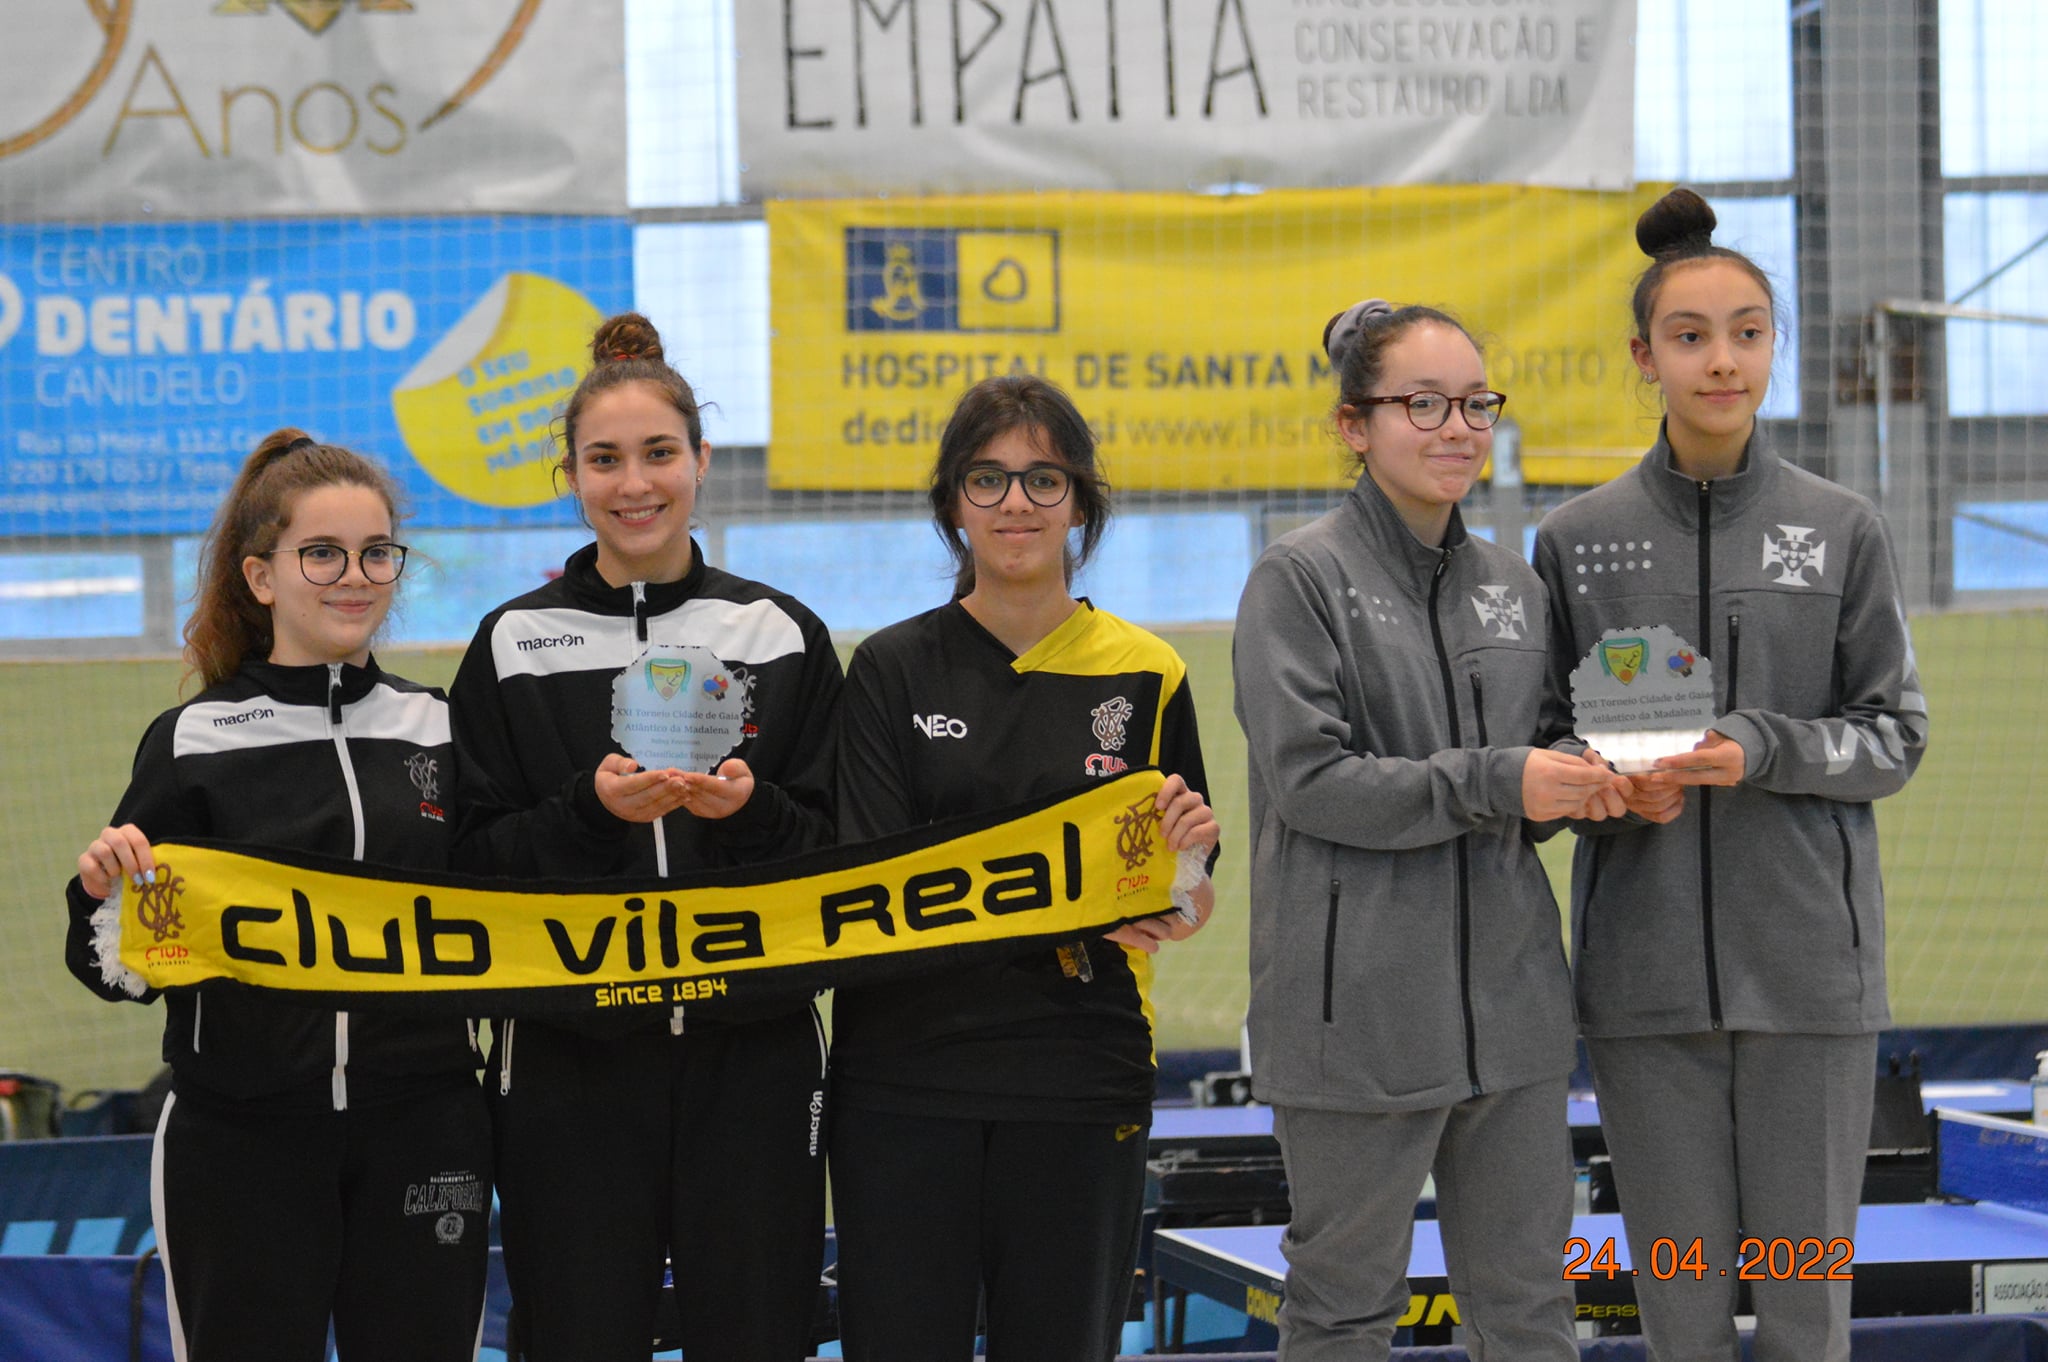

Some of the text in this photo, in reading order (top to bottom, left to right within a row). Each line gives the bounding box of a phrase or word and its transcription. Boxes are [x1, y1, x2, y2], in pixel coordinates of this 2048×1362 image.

[1574, 15, 1600, 62] E
[103, 45, 409, 158] Anos
[1297, 71, 1569, 119] RESTAURO LDA
[34, 244, 205, 287] CENTRO
[37, 279, 417, 355] DENTÁRIO
[36, 362, 248, 407] CANIDELO
[842, 352, 1048, 388] HOSPITAL
[1076, 354, 1129, 389] DE
[1145, 353, 1292, 388] SANTA
[515, 634, 585, 652] macron
[616, 708, 739, 721] XXI Torneio Cidade de Gaia
[1580, 691, 1709, 710] XXI Torneio Cidade de Gaia
[1591, 707, 1702, 724] Atlântico da Madalena
[213, 706, 275, 728] macron
[624, 722, 730, 735] Atlântico da Madalena
[913, 713, 968, 740] NEO
[690, 751, 719, 762] Equipas
[220, 822, 1082, 976] club vila Real
[595, 977, 728, 1007] since 1894
[809, 1090, 823, 1157] macron
[1575, 1304, 1641, 1319] PERS
